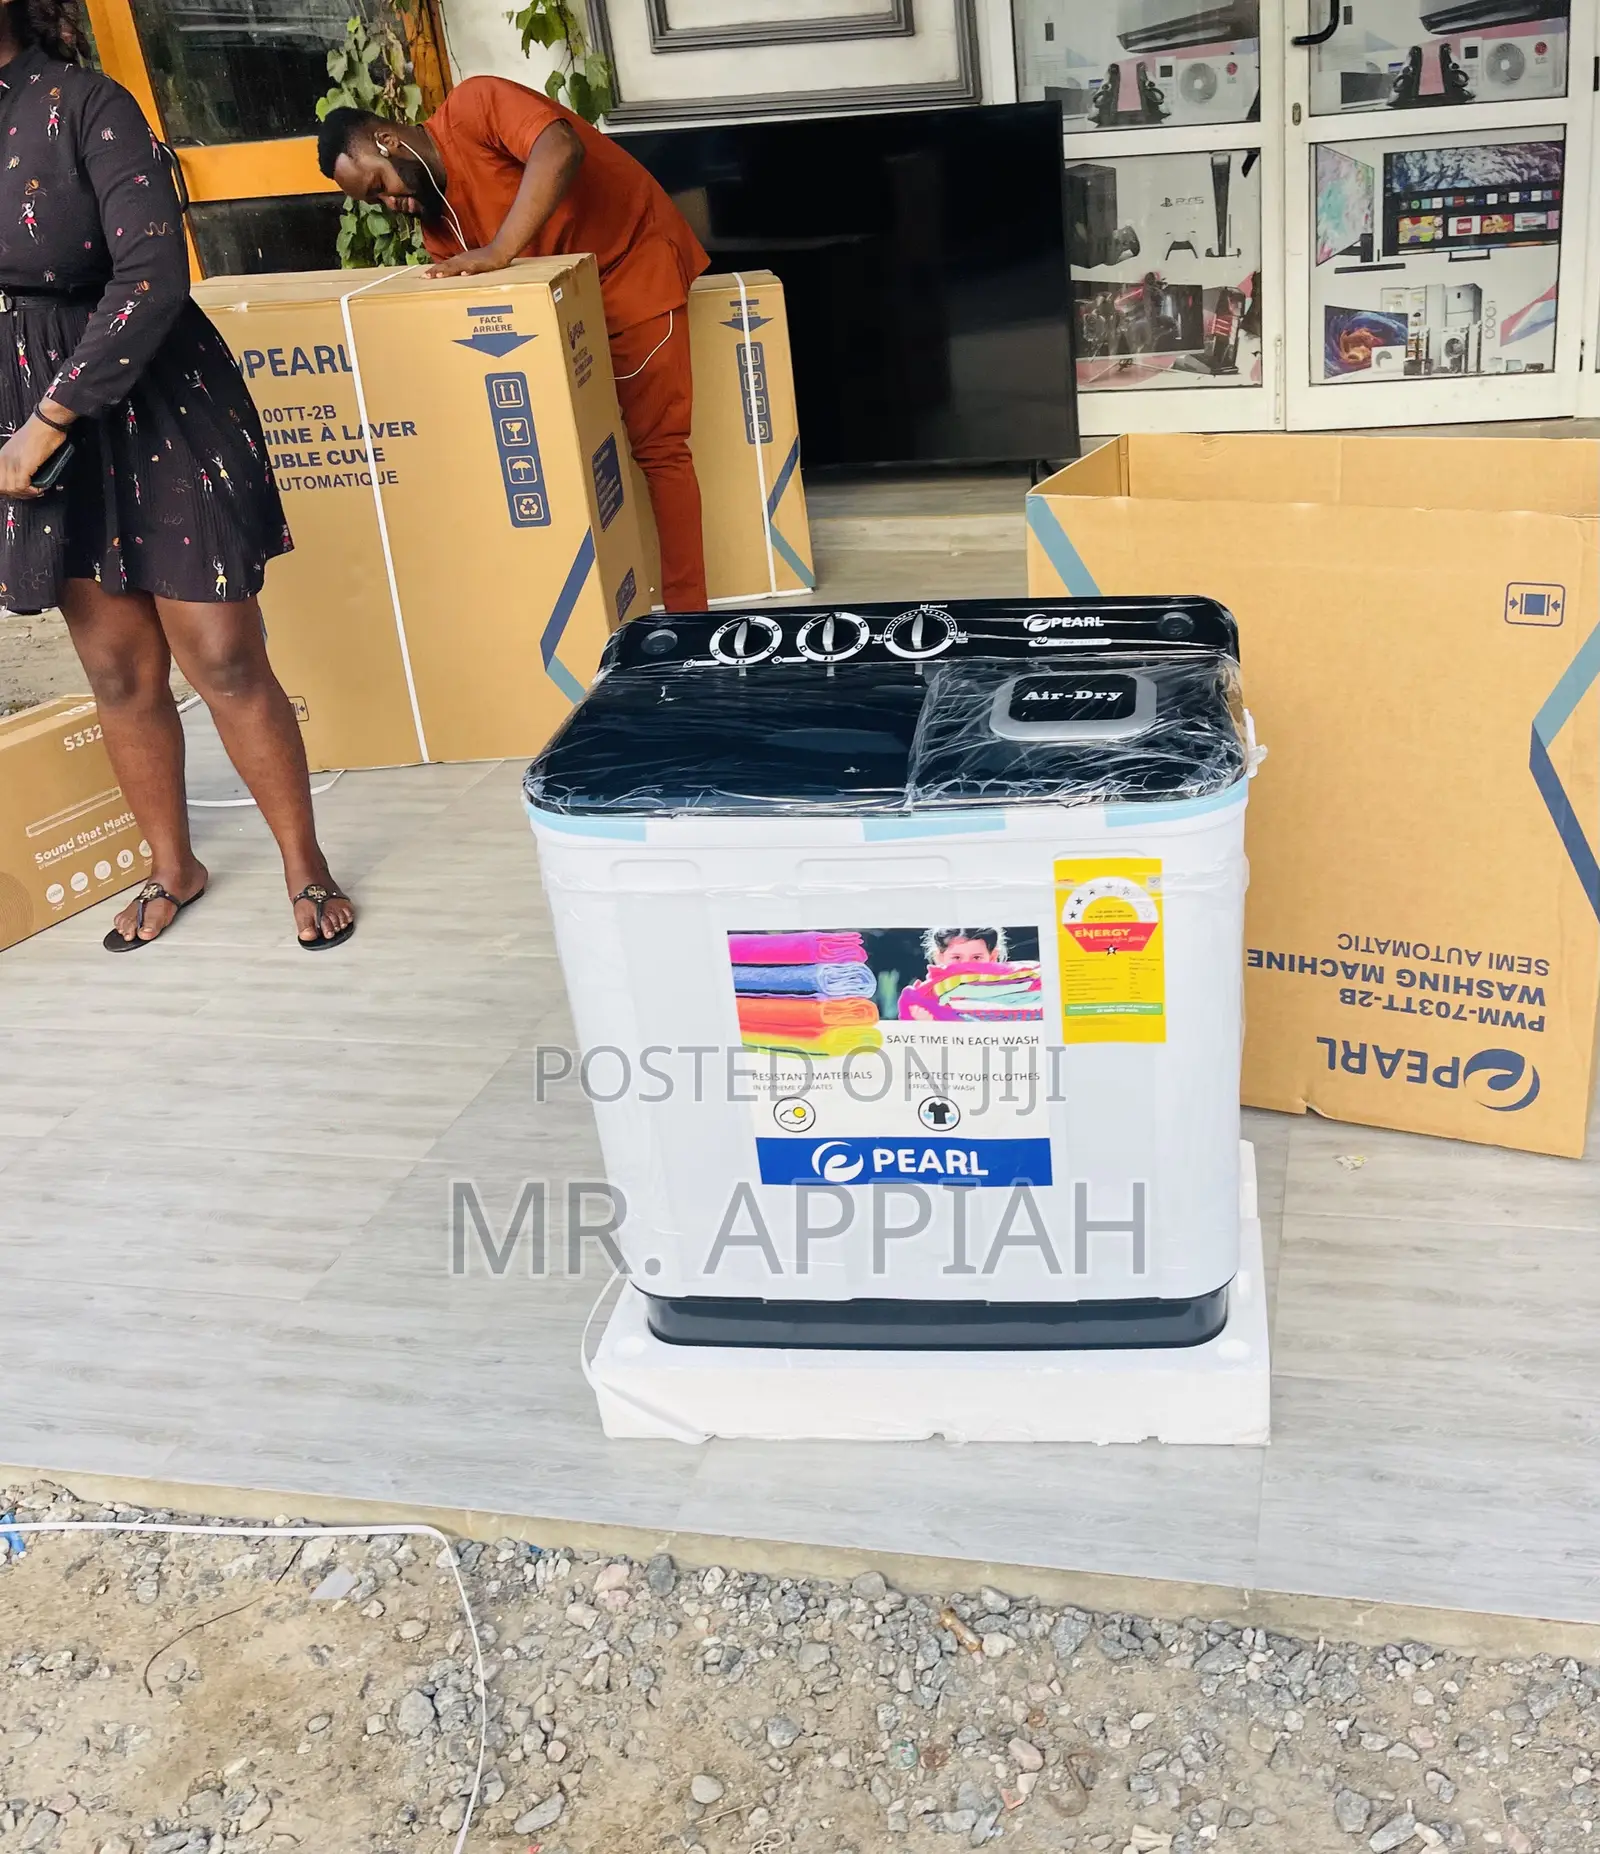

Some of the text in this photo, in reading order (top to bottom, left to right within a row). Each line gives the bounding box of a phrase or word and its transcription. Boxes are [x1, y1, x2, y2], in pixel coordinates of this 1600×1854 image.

[480, 315, 503, 324] FACE
[243, 344, 353, 379] PEARL
[262, 404, 337, 424] 00TT-2B
[320, 422, 336, 442] À
[326, 447, 386, 466] CUVE
[1050, 616, 1104, 628] PEARL
[1022, 690, 1123, 701] Air-Dry
[63, 724, 103, 751] S332
[34, 837, 75, 864] Sound
[77, 826, 102, 845] that
[1074, 927, 1131, 940] ENERGY
[1337, 933, 1550, 977] SEMI AUTOMATIC
[1247, 949, 1546, 1007] WASHING MACHINE
[1339, 988, 1545, 1032] PWM-703TT-2B
[886, 1034, 1040, 1046] SAVE TIME IN EACH WASH
[1316, 1036, 1460, 1089] PEARL
[752, 1071, 873, 1081] RESISTANT MATERIALS
[907, 1071, 1040, 1081] PROTECT YOUR CLOTHES
[873, 1148, 989, 1177] PEARL
